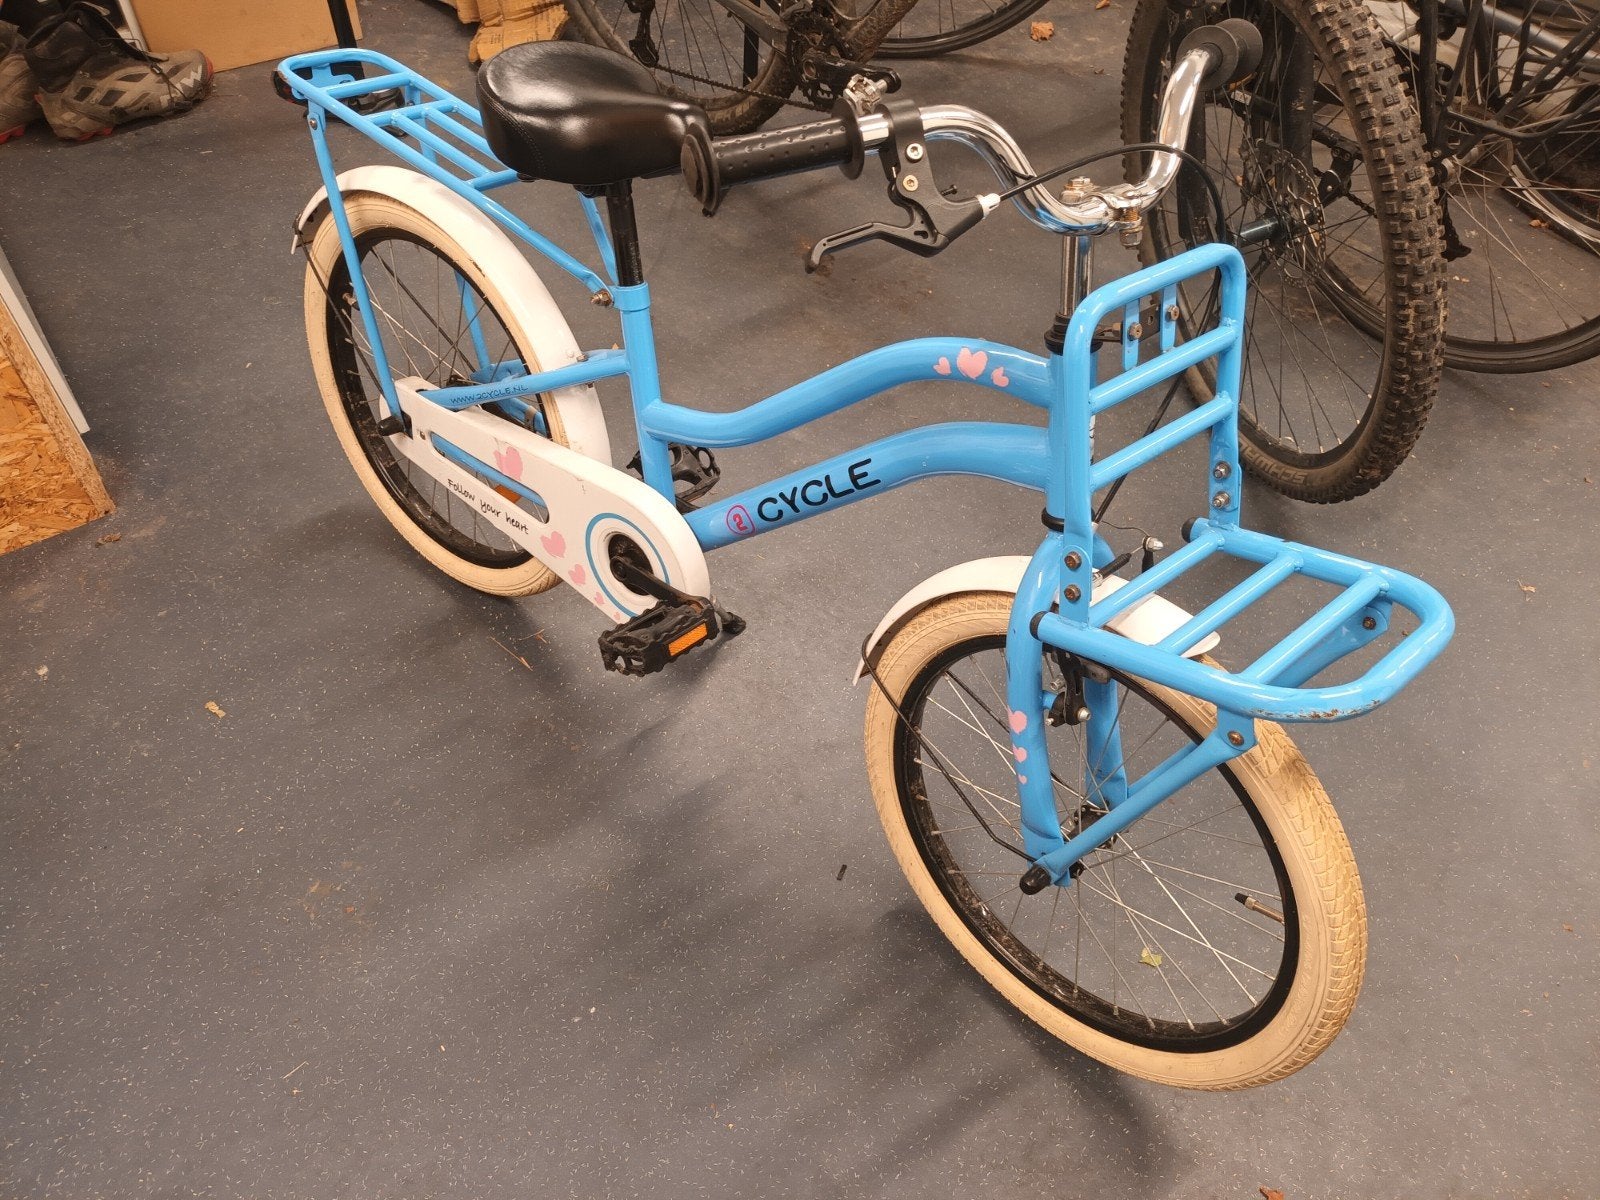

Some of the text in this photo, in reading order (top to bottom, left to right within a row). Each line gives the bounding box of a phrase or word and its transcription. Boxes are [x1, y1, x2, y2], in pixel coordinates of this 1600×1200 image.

[447, 478, 529, 535] Follow your heart
[757, 458, 882, 523] CYCLE
